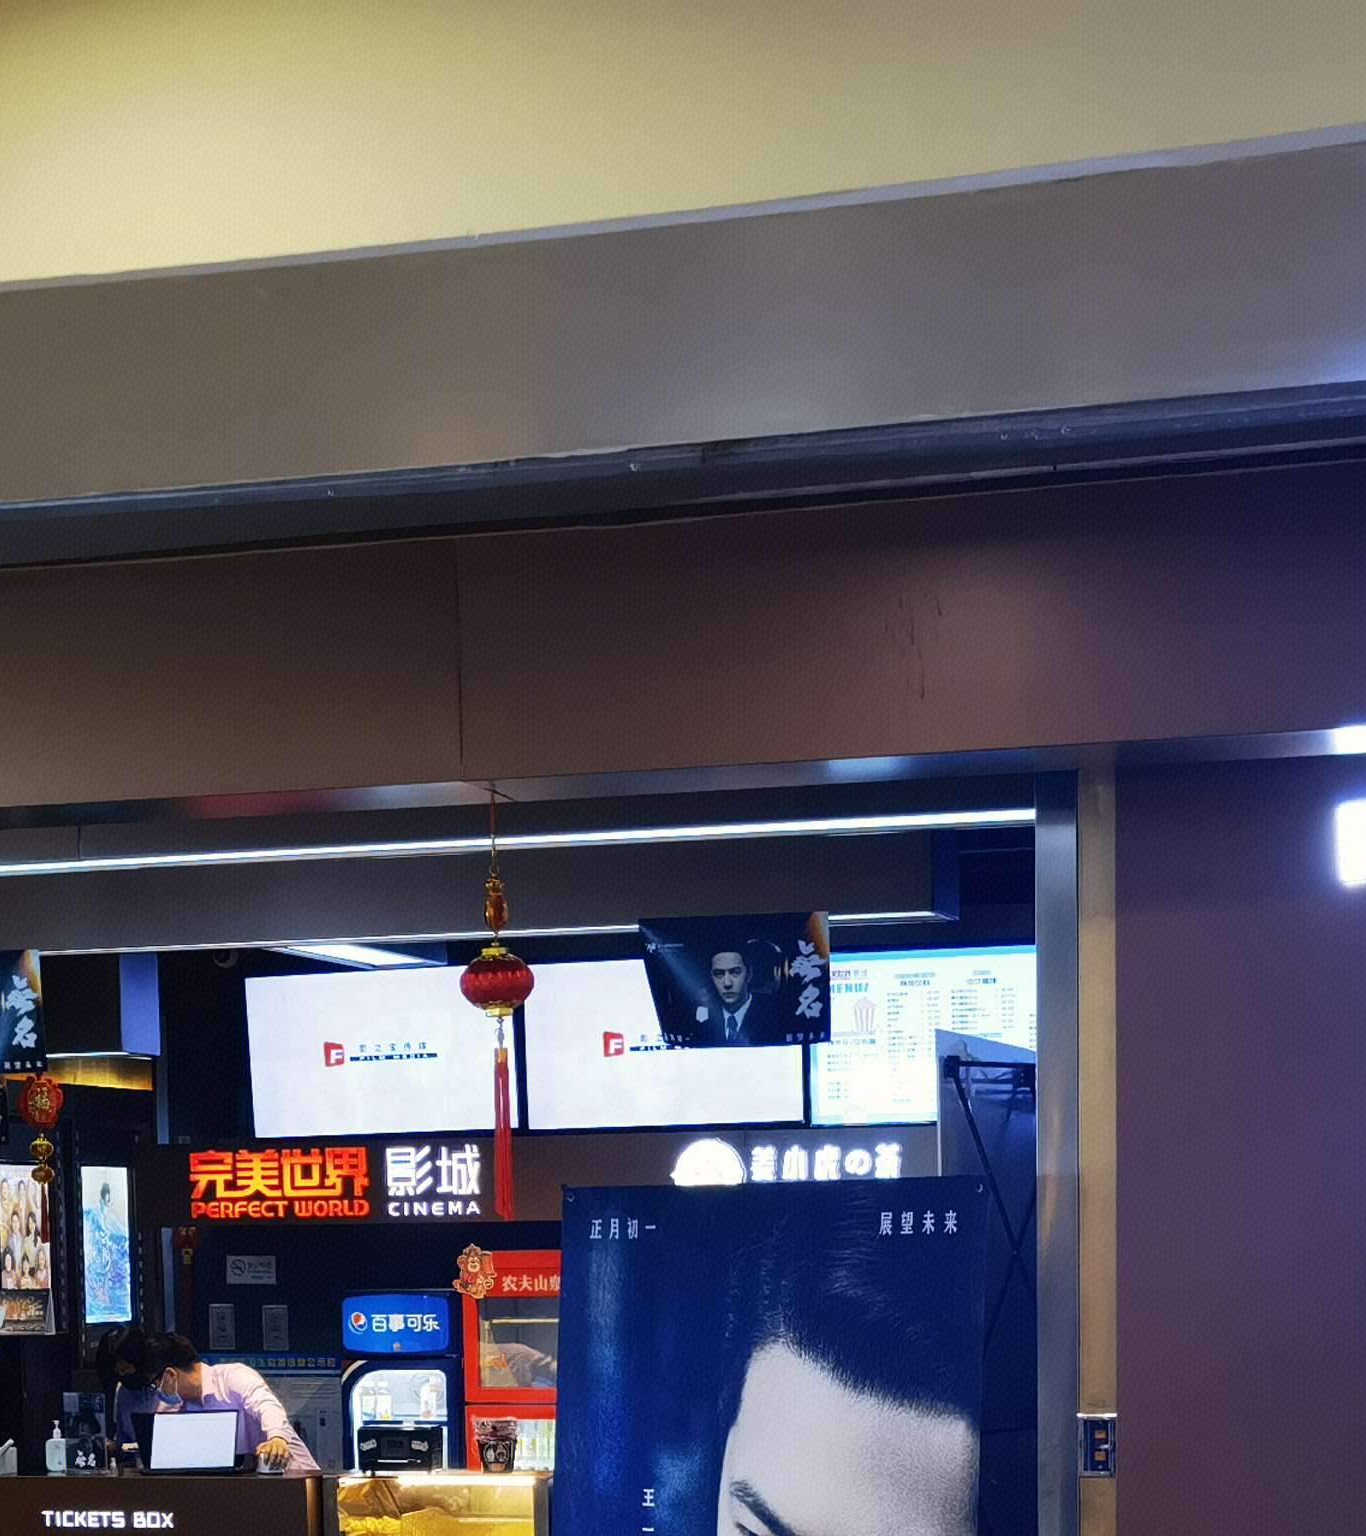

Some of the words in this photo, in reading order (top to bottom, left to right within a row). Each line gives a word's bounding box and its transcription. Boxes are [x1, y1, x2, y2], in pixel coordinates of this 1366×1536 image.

[189, 1146, 370, 1198] 完美世界
[386, 1143, 481, 1196] 影城
[191, 1200, 288, 1219] PERFECT
[294, 1199, 370, 1218] WORLD
[387, 1201, 481, 1217] CINEMA
[589, 1217, 657, 1241] 正月初一
[878, 1210, 958, 1237] 展望未来
[371, 1314, 440, 1333] 百事可乐
[41, 1509, 126, 1529] TICKETS
[133, 1511, 175, 1529] BOX
